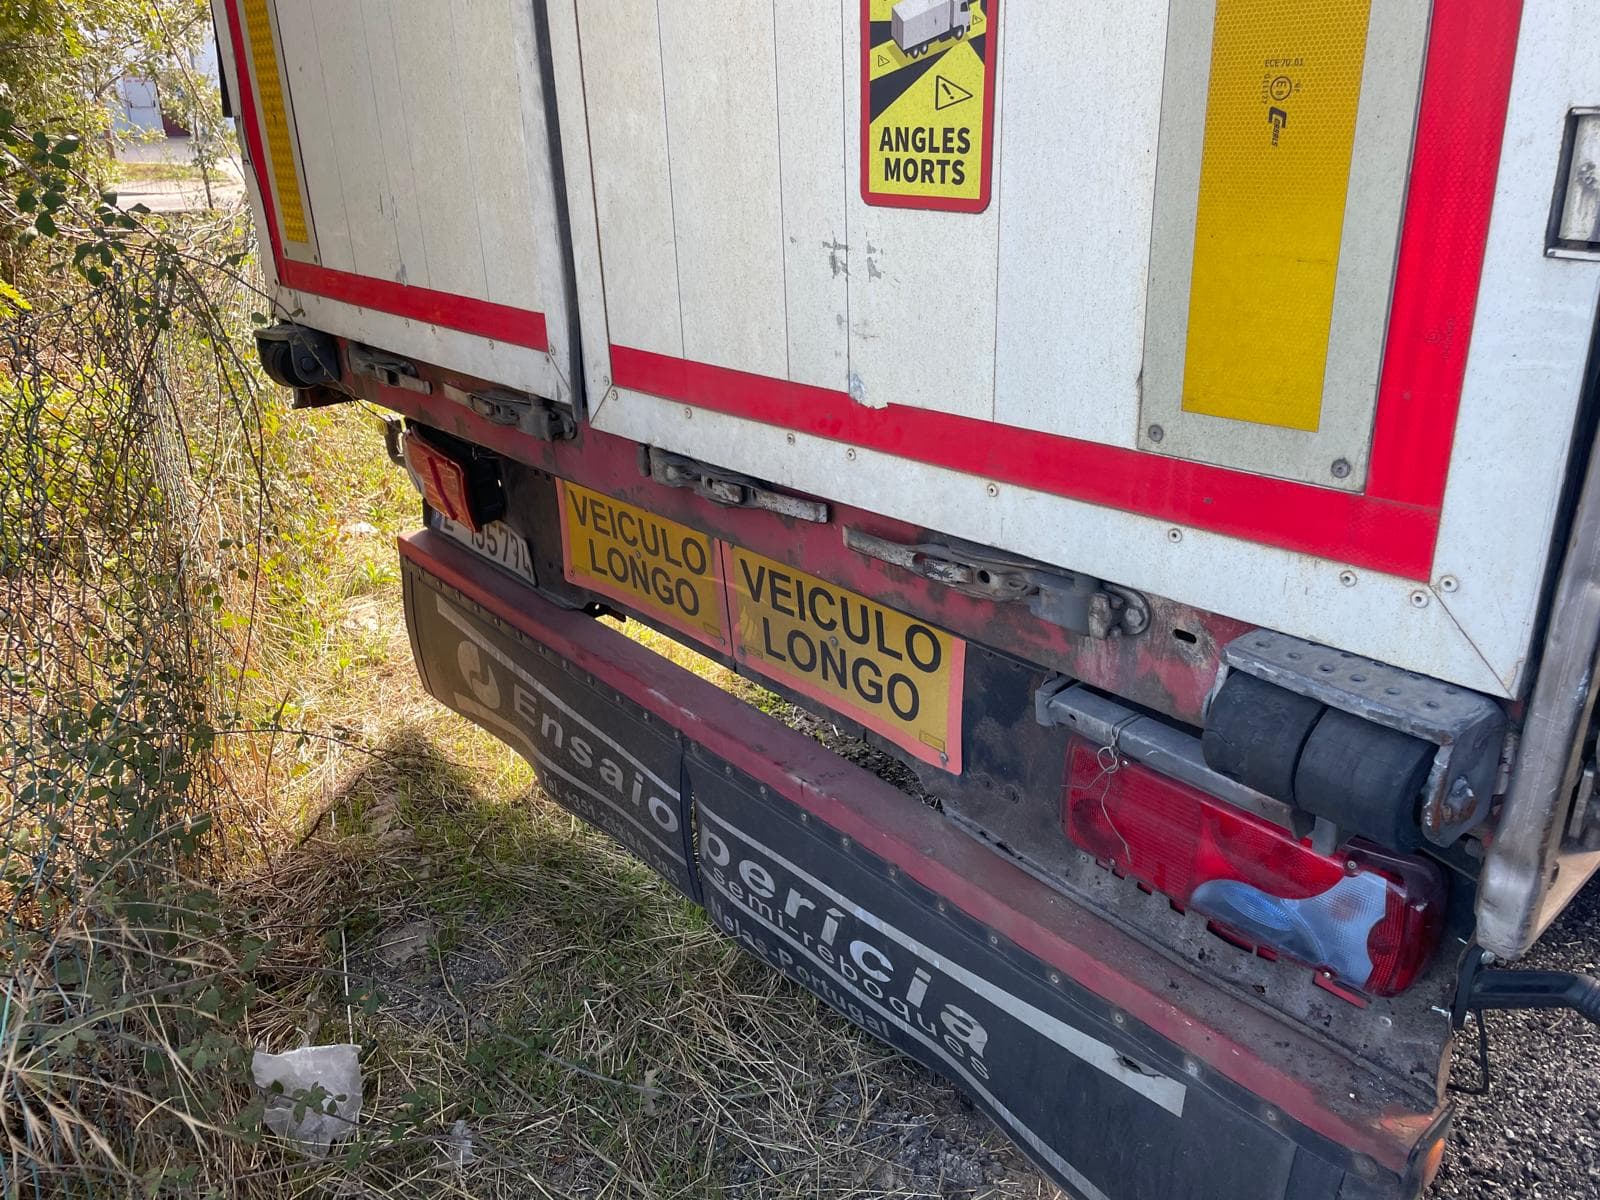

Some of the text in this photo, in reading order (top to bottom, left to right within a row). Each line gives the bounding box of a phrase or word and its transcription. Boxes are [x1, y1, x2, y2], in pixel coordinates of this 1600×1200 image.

[879, 126, 971, 155] ANGLES
[884, 157, 965, 186] MORTS
[569, 489, 707, 576] VEICULO
[588, 538, 700, 617] LONGO
[739, 558, 942, 674] VEICULO
[762, 616, 920, 722] LONGO
[713, 867, 990, 1080] semi-reboques
